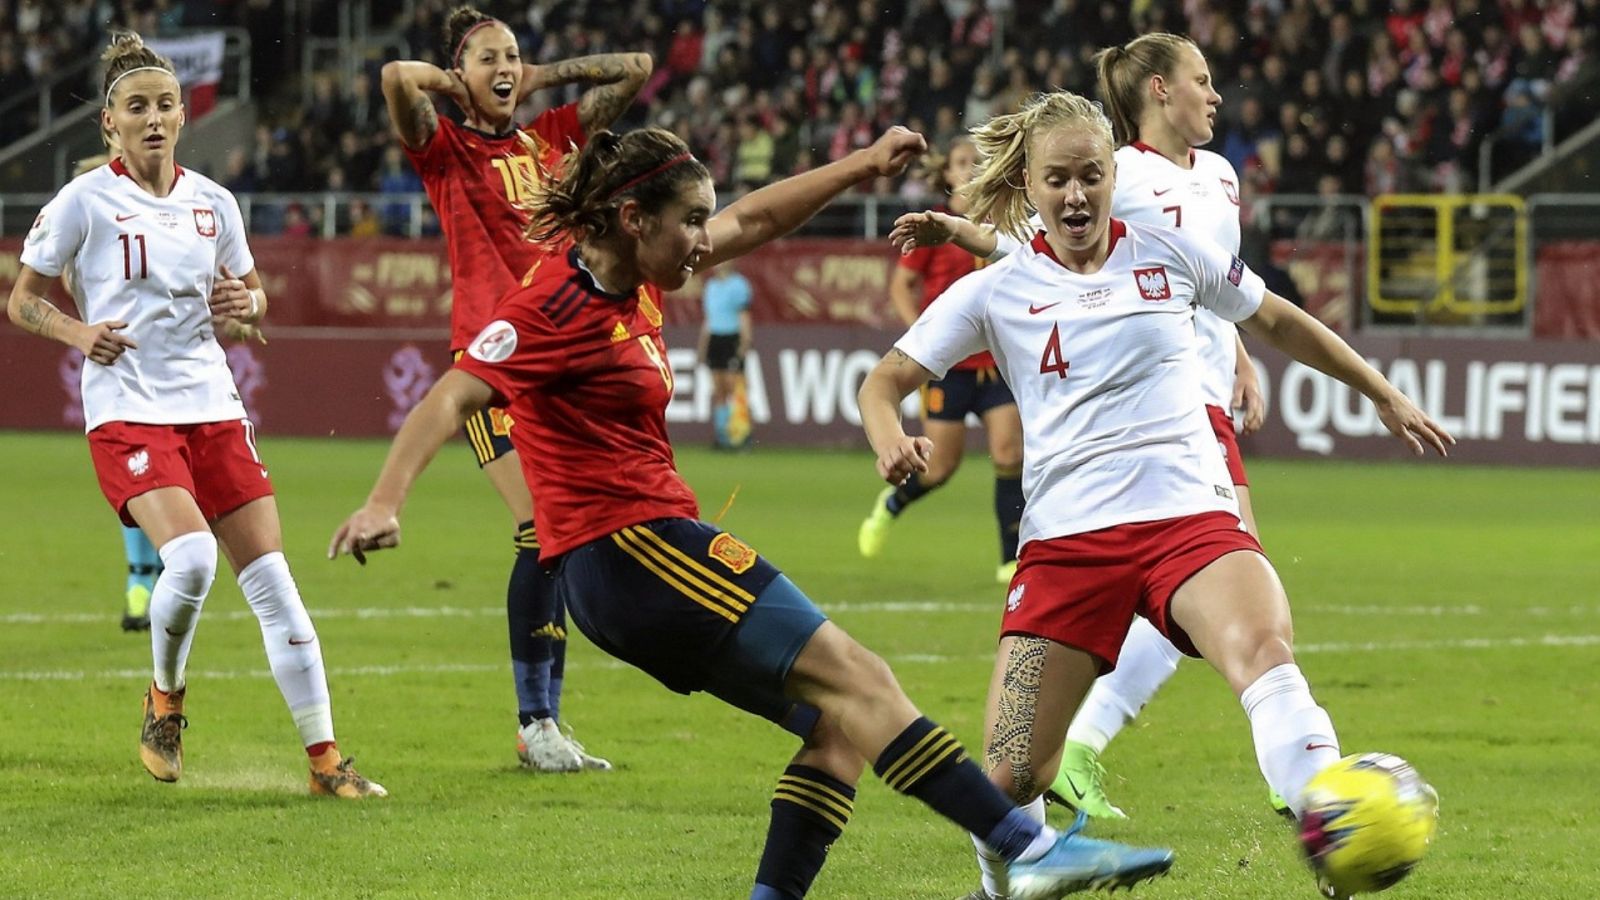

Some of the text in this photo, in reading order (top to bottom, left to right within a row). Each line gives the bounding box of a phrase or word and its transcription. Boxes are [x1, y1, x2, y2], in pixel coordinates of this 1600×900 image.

[491, 155, 541, 202] 10
[1163, 205, 1181, 228] 7
[118, 233, 148, 280] 11
[638, 334, 673, 392] 8
[1040, 319, 1070, 379] 4
